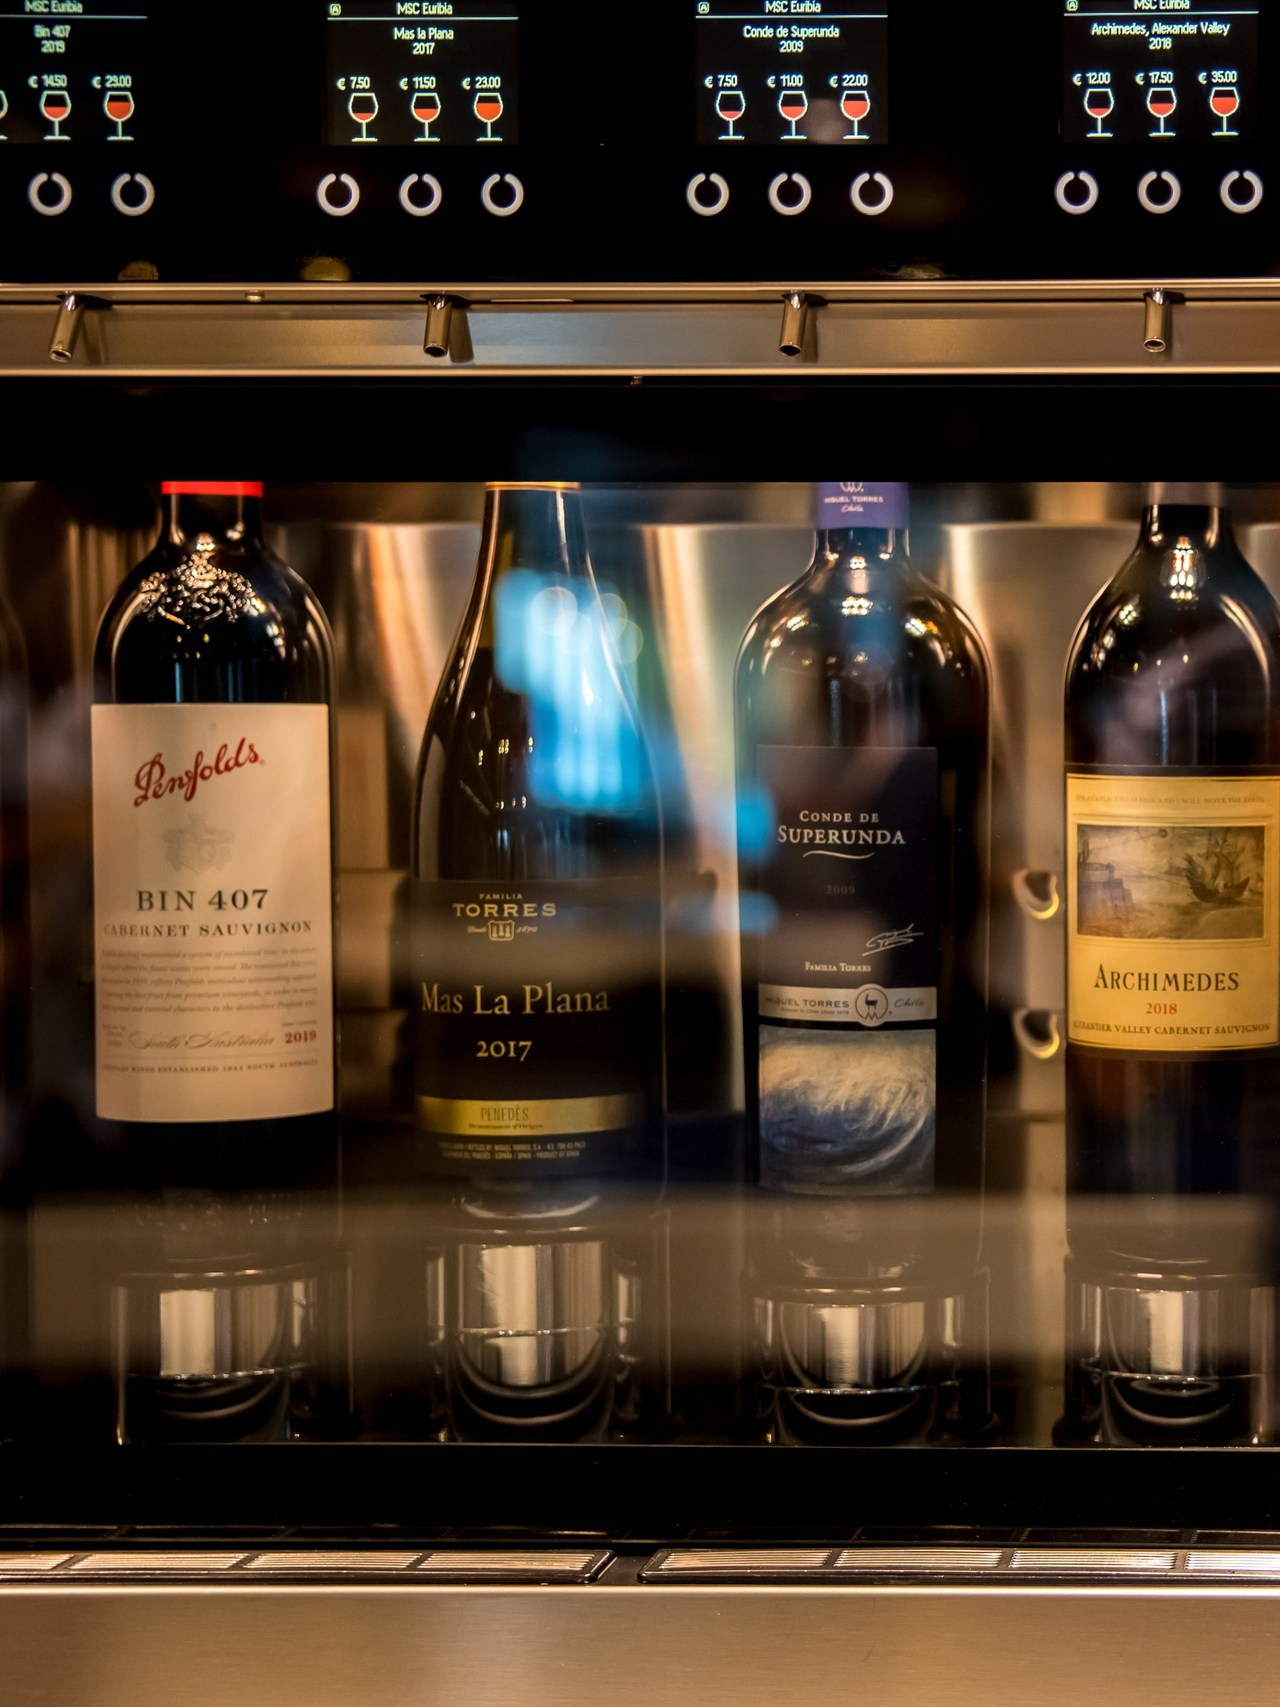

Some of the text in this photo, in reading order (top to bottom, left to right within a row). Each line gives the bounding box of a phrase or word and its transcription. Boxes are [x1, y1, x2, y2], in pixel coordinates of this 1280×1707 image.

[397, 3, 453, 15] MSC Euribia
[765, 1, 821, 13] MSC Euribia
[1134, 0, 1158, 10] MSC
[34, 24, 71, 38] Bin 407
[393, 27, 454, 40] Mas la Plana
[743, 25, 840, 40] Conde de Superunda
[1091, 22, 1230, 37] Archimedes, Alexander Valley
[41, 40, 65, 53] 2019
[412, 42, 435, 55] 2017
[779, 41, 803, 52] 2009
[1149, 38, 1172, 50] 2018
[350, 76, 370, 89] 7.50
[475, 76, 501, 89] 23.00
[842, 74, 868, 87] 22.00
[1086, 72, 1111, 84] 12.00
[1148, 71, 1173, 84] 17.50
[1211, 70, 1238, 83] 35.00
[133, 737, 260, 807] Penfolds
[799, 810, 879, 823] CONDE DE
[778, 825, 906, 845] SUPERUNDA
[825, 885, 855, 895] 2009
[136, 888, 268, 912] BIN 407
[452, 903, 557, 917] TORRES
[103, 920, 312, 937] CABERNET SAUVIGNON
[1094, 963, 1239, 992] ARCHIMEDES
[421, 981, 610, 1015] Mas La Plana
[803, 999, 849, 1008] TORRES
[1146, 1003, 1178, 1015] 2018
[1114, 1024, 1151, 1034] VALLEY
[1154, 1026, 1211, 1035] CABERNET
[1214, 1023, 1271, 1034] SAUVIGNON
[285, 1030, 317, 1044] 2019
[476, 1040, 533, 1062] 2017
